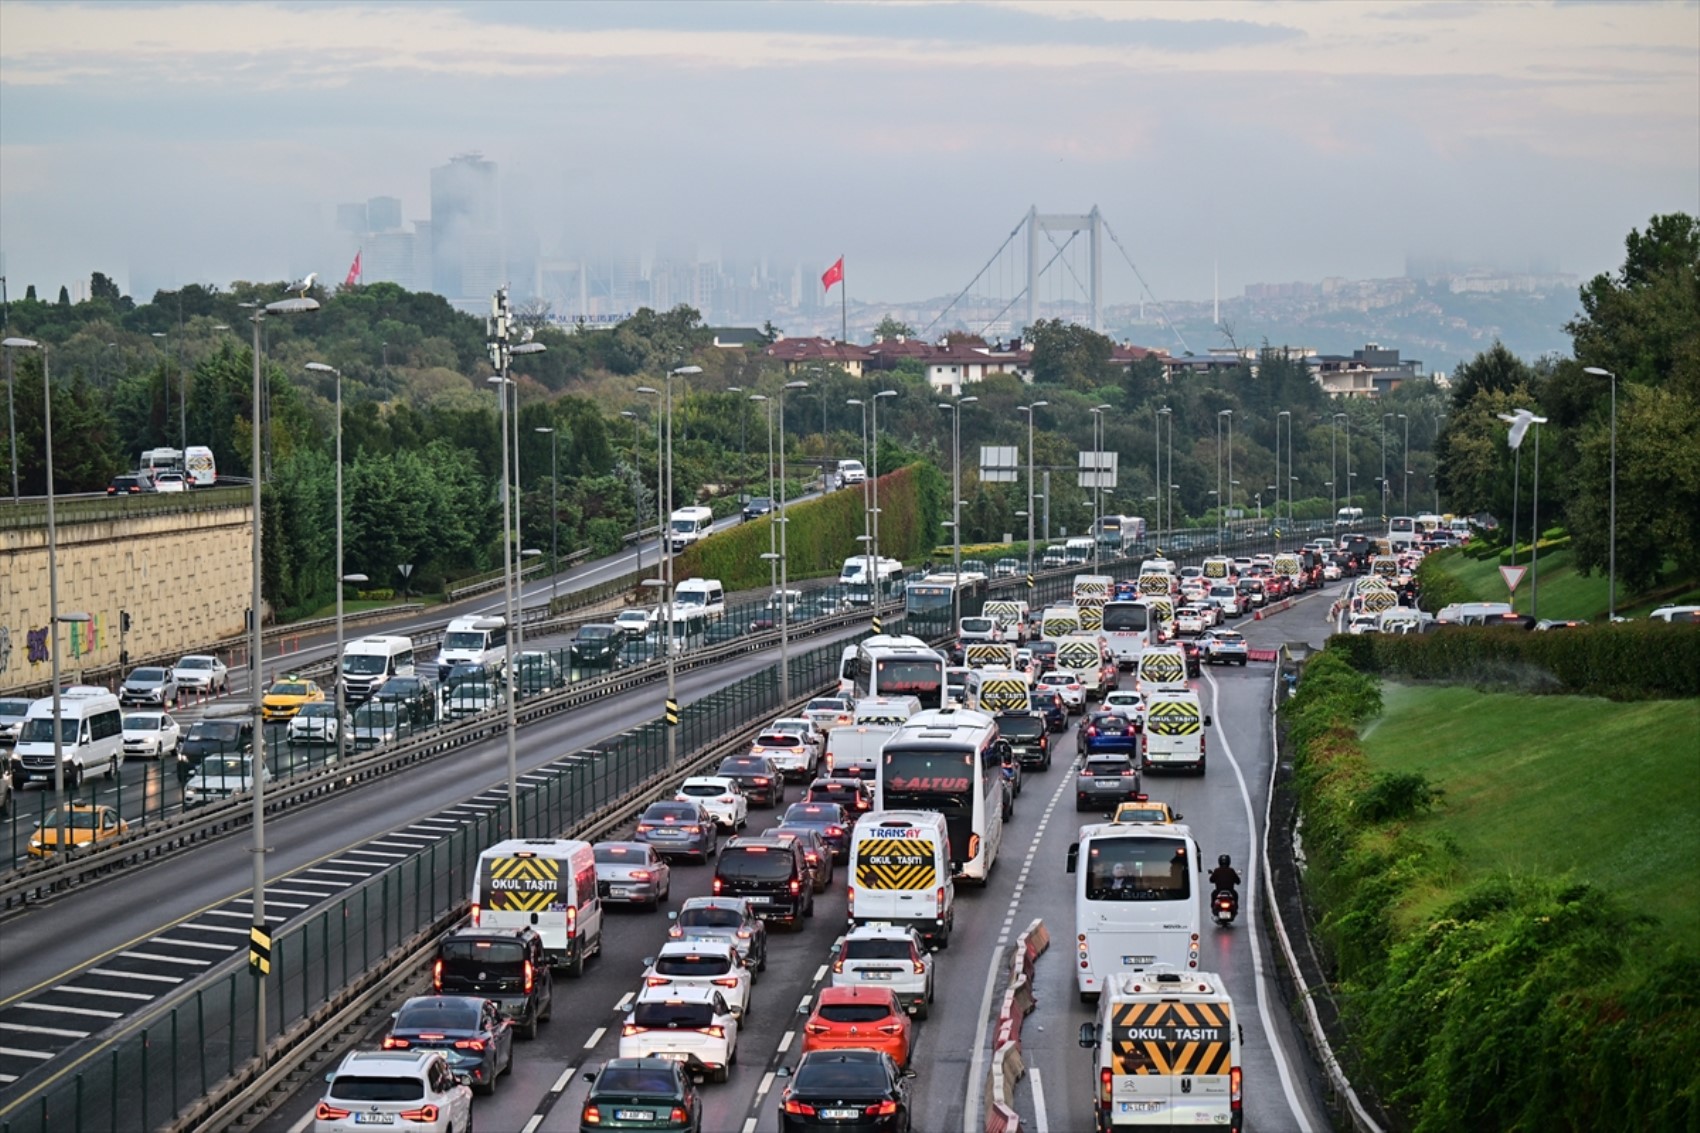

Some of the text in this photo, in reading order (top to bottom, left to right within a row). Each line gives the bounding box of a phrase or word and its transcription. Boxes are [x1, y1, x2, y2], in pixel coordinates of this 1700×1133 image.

[895, 681, 938, 691] ALTUR
[906, 777, 968, 789] ALTUR
[870, 828, 921, 838] TRANSAY
[869, 856, 891, 865] OKUL
[492, 879, 557, 891] OKUL TAŞITI
[1128, 1028, 1166, 1039] OKUL
